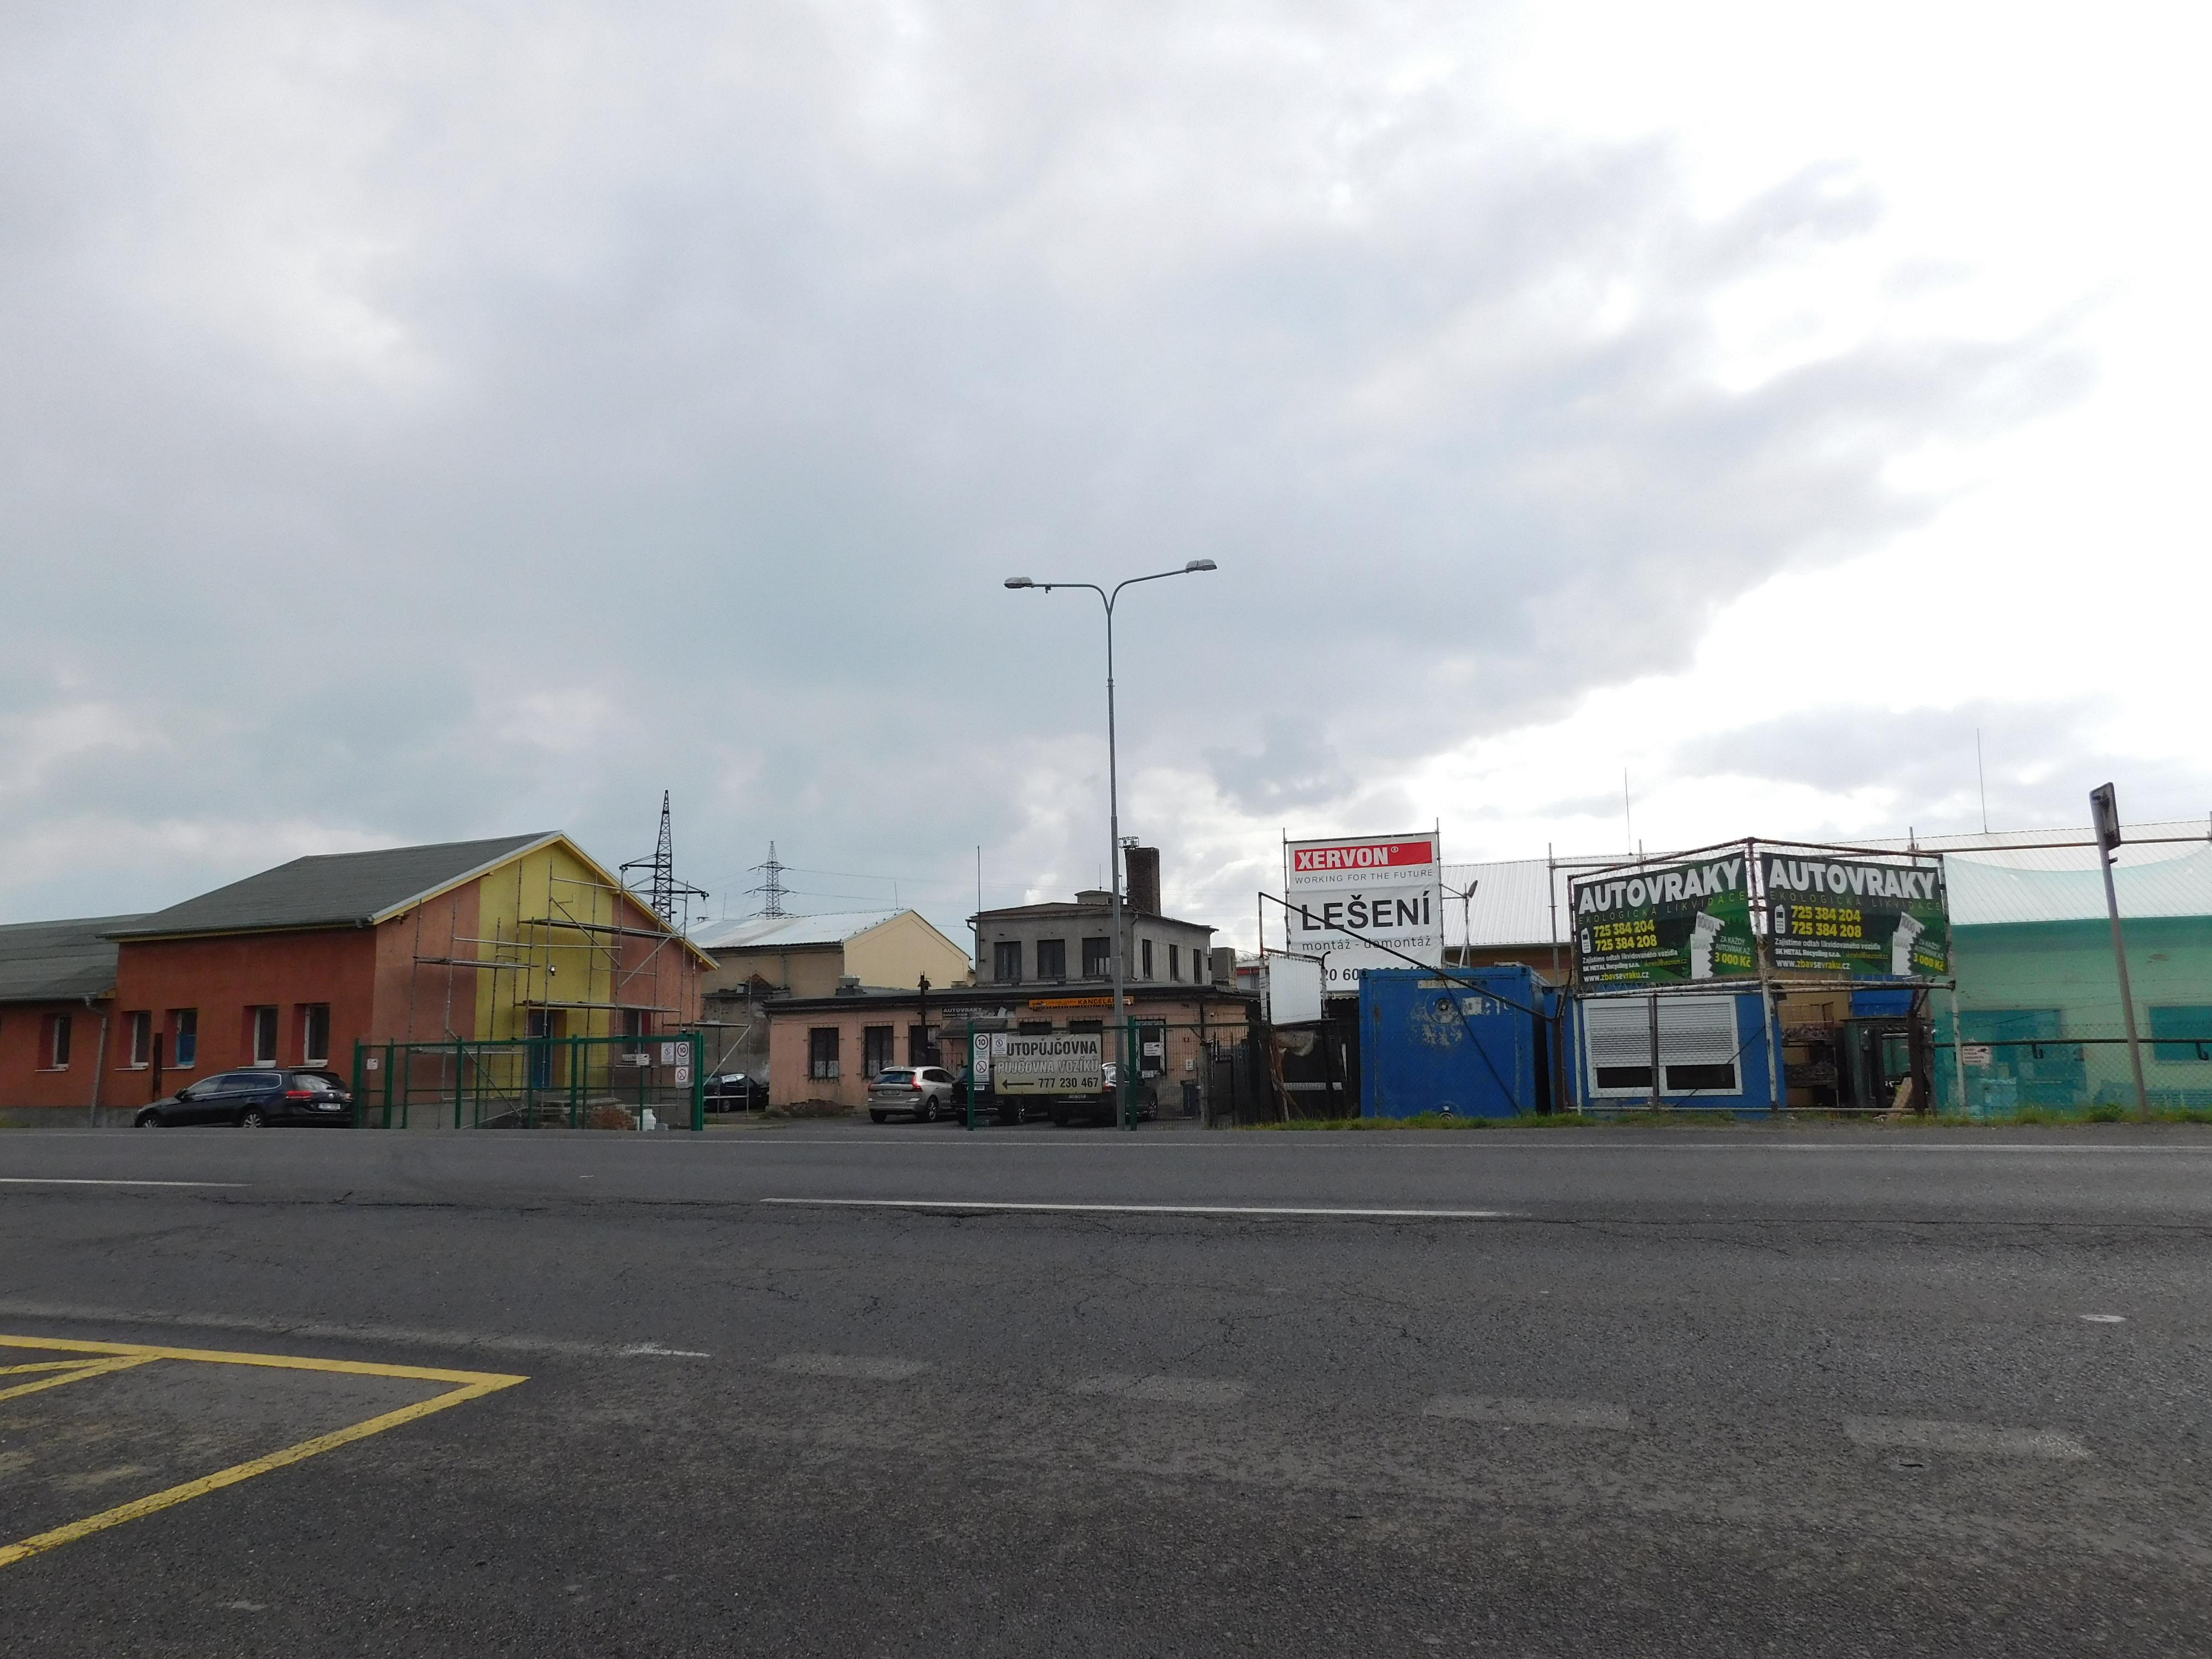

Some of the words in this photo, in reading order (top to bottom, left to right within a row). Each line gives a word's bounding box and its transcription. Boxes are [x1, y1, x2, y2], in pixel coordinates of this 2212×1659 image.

[1295, 875, 1343, 884] WORKING
[1394, 869, 1433, 878] FUTURE
[1769, 859, 1935, 899] AUTOVRAKY
[1579, 858, 1741, 914] AUTOVRAKY
[1667, 891, 1744, 913] LIKVIDACE
[1301, 890, 1430, 931] LEŠENÍ
[1791, 905, 1813, 919] 725
[1814, 907, 1837, 921] 384
[1838, 909, 1861, 922] 204
[1593, 925, 1611, 937] 725
[1613, 922, 1632, 935] 384
[1633, 919, 1655, 933] 204
[1791, 921, 1813, 935] 725
[1815, 922, 1837, 936] 384
[1839, 925, 1862, 938] 208
[1302, 938, 1351, 951] montáž
[1595, 938, 1614, 952] 725
[1615, 936, 1635, 950] 384
[1636, 935, 1657, 948] 208
[1715, 943, 1743, 953] AUTOVRAK
[1820, 941, 1860, 950] likvidovaného
[1621, 952, 1656, 960] likvidovaného
[1715, 952, 1720, 962] 3
[1721, 953, 1739, 966] 000
[1740, 956, 1751, 967] Kč
[1803, 950, 1828, 958] Recycling
[1913, 952, 1918, 962] 3
[1919, 955, 1933, 967] 000
[1935, 959, 1944, 971] Kč
[1776, 959, 1850, 969] www.zbavsevraku.cz
[1343, 968, 1368, 981] 60
[1583, 971, 1649, 983] www.zbavsevraku.cz
[1007, 1037, 1098, 1056] UTOPŮJČOVNA
[997, 1057, 1055, 1073] PŮJČOVNA
[1058, 1056, 1099, 1073] VOZÍKŮ
[1038, 1078, 1055, 1088] 777
[1060, 1078, 1077, 1088] 230
[1081, 1077, 1099, 1087] 467
